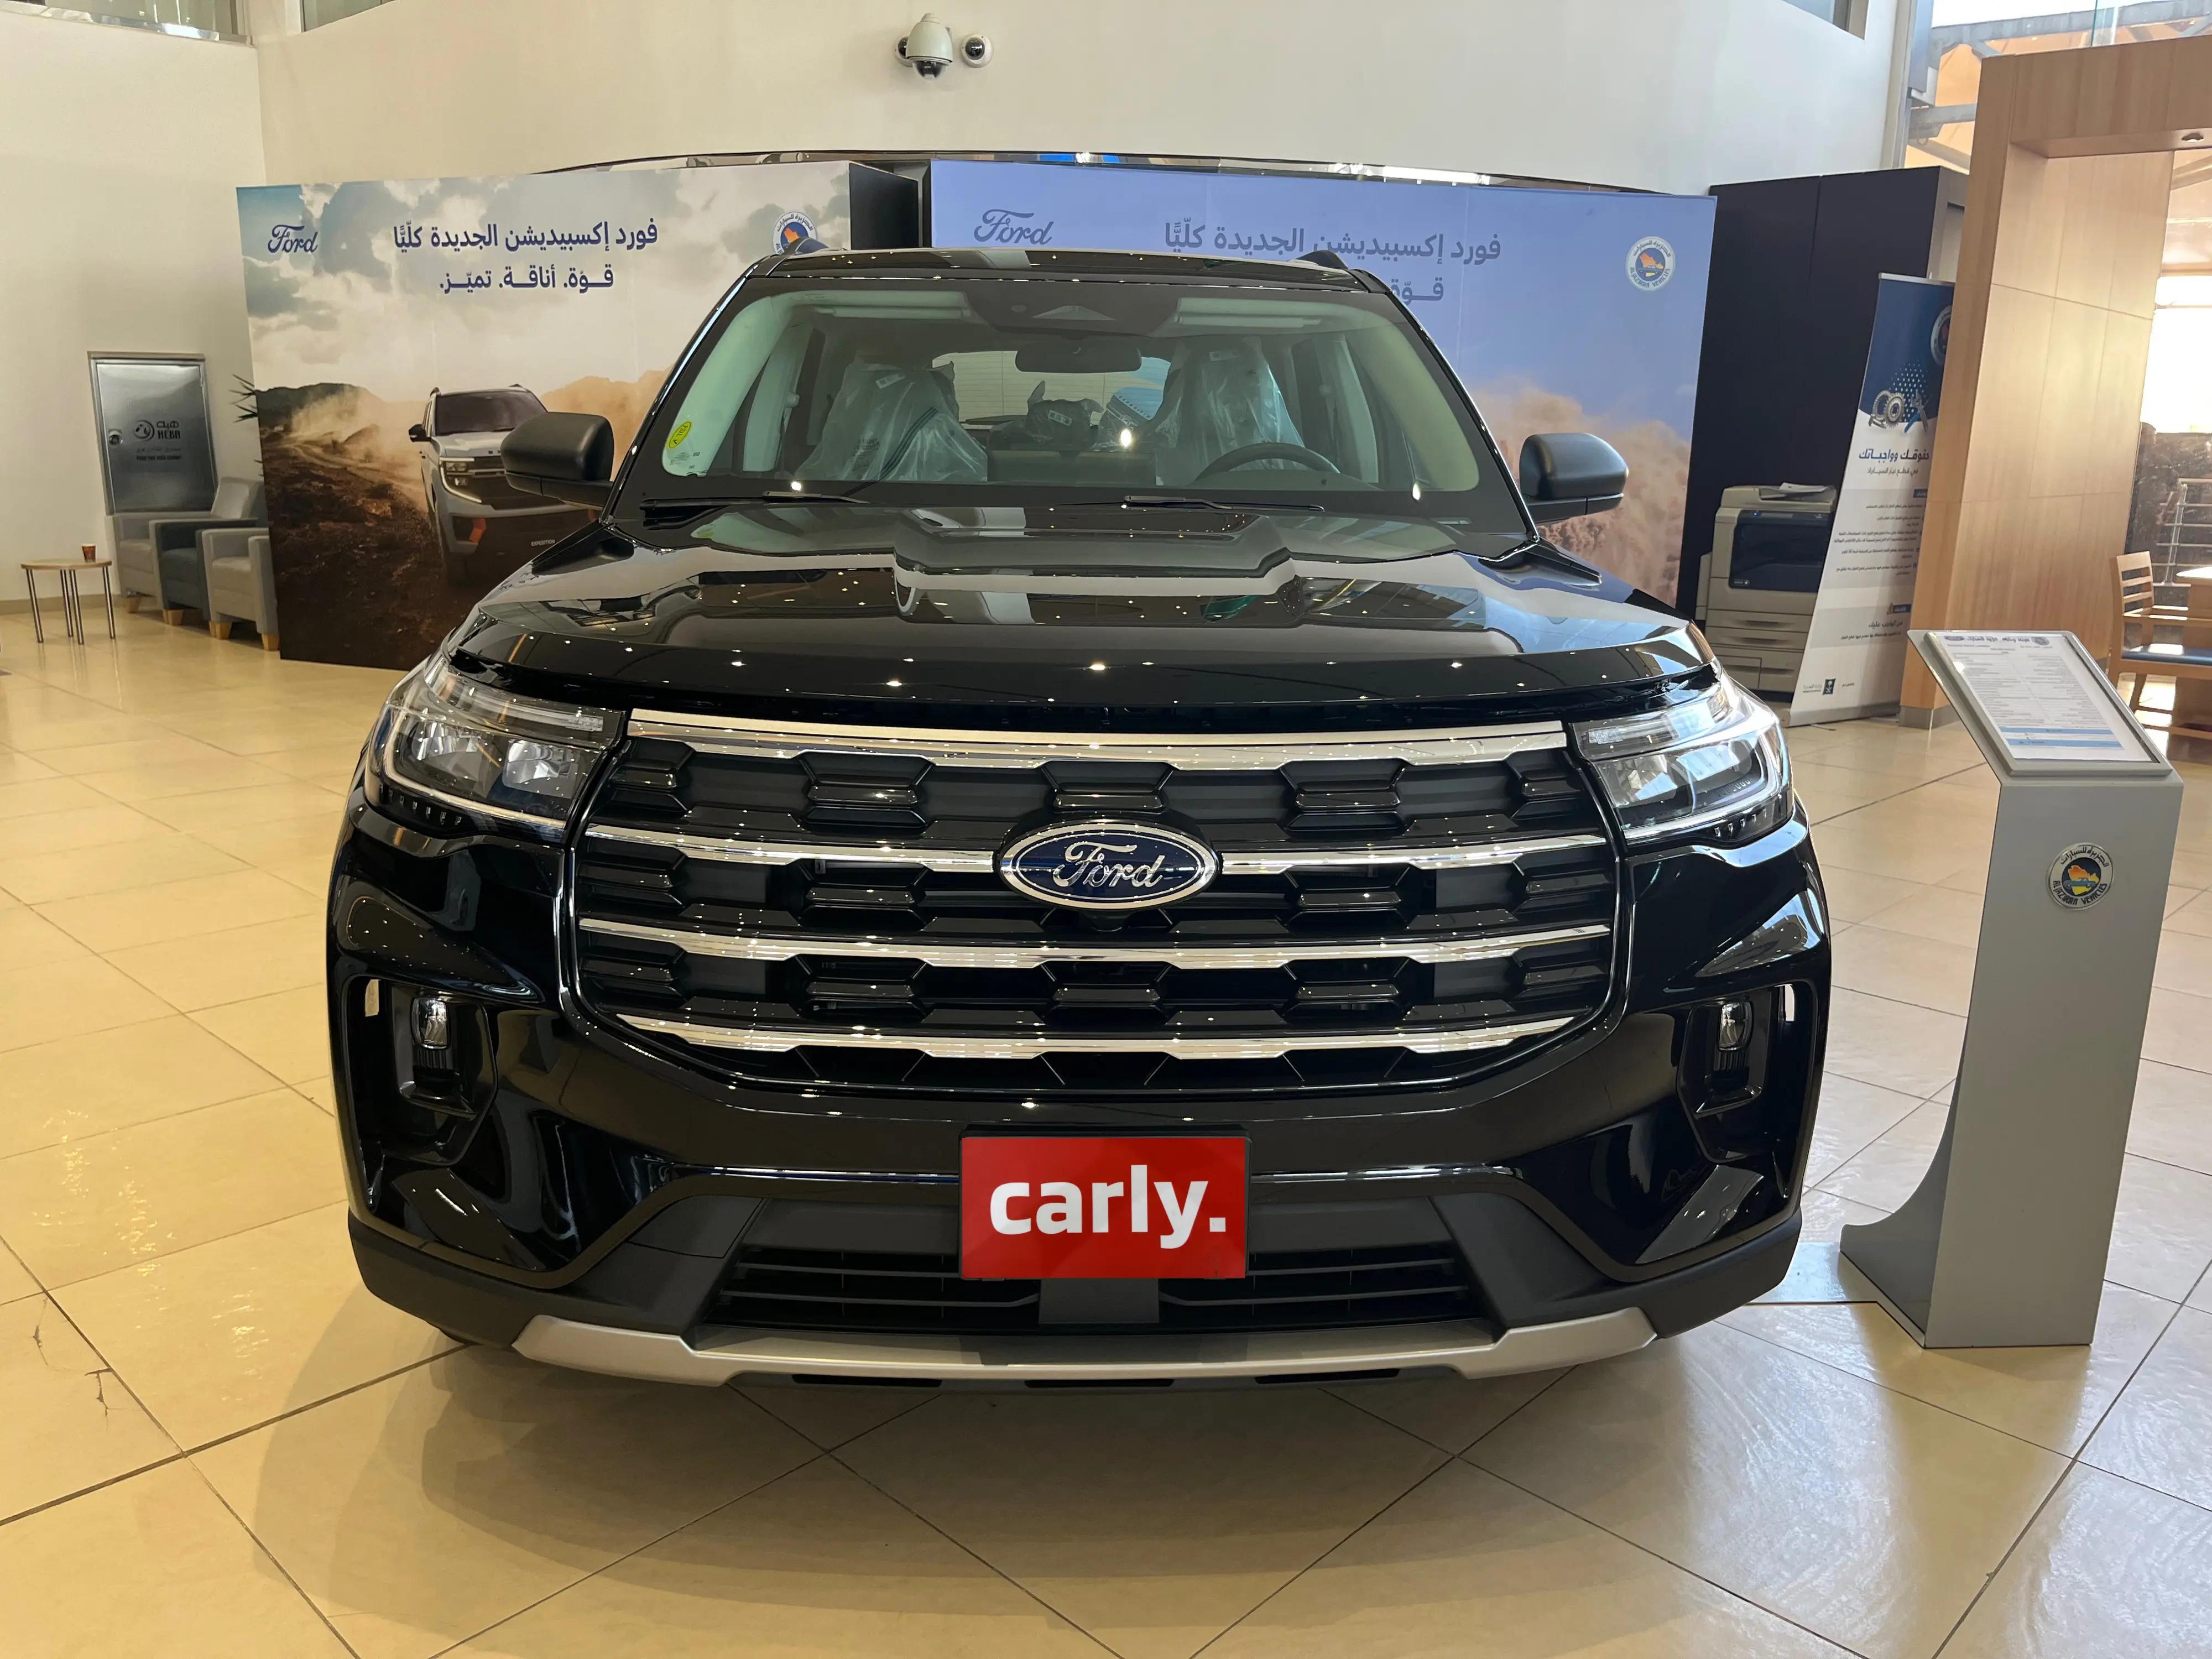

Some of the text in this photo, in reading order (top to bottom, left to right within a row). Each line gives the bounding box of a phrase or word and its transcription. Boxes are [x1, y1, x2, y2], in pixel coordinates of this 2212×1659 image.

[268, 225, 319, 253] Ford
[431, 223, 498, 252] الجديدة
[505, 221, 610, 252] إكسبيديشن
[615, 218, 658, 251] فورد
[974, 208, 1055, 245] Ford
[1214, 228, 1304, 255] الجديدة
[1451, 233, 1501, 265] فورد
[499, 264, 556, 289] أناقة.
[1900, 448, 1929, 462] قوقك
[1052, 841, 1166, 888] Ford
[2081, 883, 2107, 905] VEHICLES
[990, 1165, 1226, 1249] carly.
